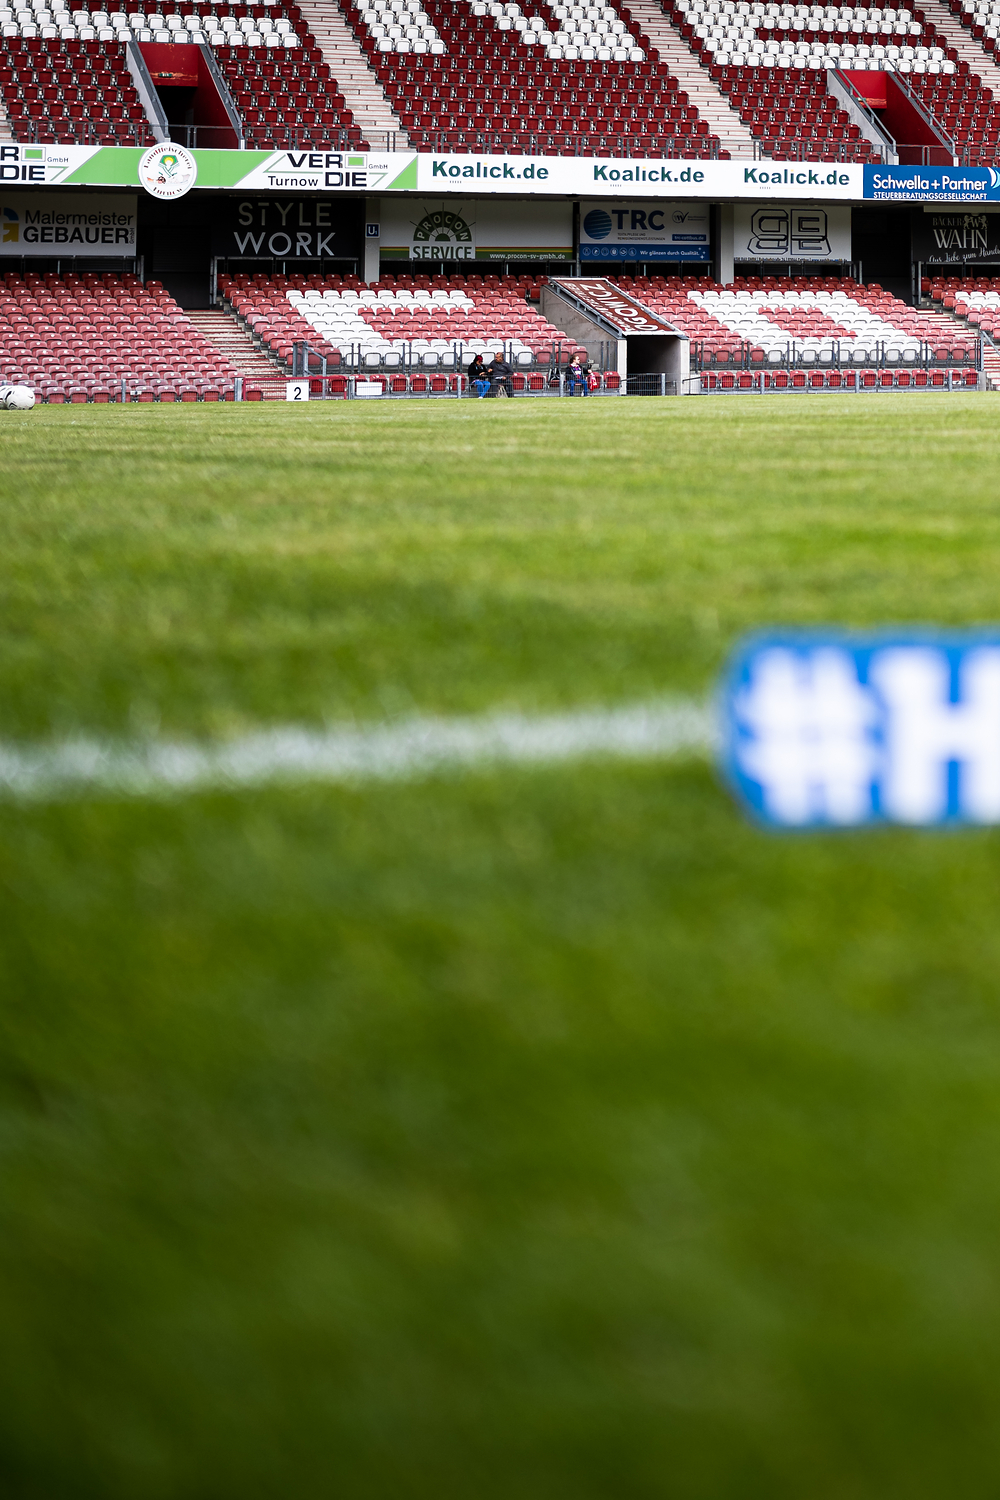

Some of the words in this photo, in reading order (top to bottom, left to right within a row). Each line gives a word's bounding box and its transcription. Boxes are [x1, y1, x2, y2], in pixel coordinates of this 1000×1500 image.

[268, 175, 319, 187] Turnow
[325, 172, 368, 187] DIE
[432, 161, 549, 180] Koalick.de
[593, 165, 705, 183] Koalick.de
[744, 167, 850, 186] Koalick.de
[872, 174, 930, 190] Schwella
[942, 176, 988, 191] Partner
[873, 191, 988, 200] STEUERBERATUNGSGESELLSCHAFT
[25, 210, 134, 226] Malermeister
[238, 202, 332, 226] STYLE
[612, 209, 665, 231] TRC
[23, 226, 129, 244] GEBAUER
[416, 214, 469, 241] PROCON
[233, 231, 336, 256] WORK
[933, 229, 988, 249] WAHN
[412, 246, 472, 259] SERVICE
[294, 386, 302, 400] 2
